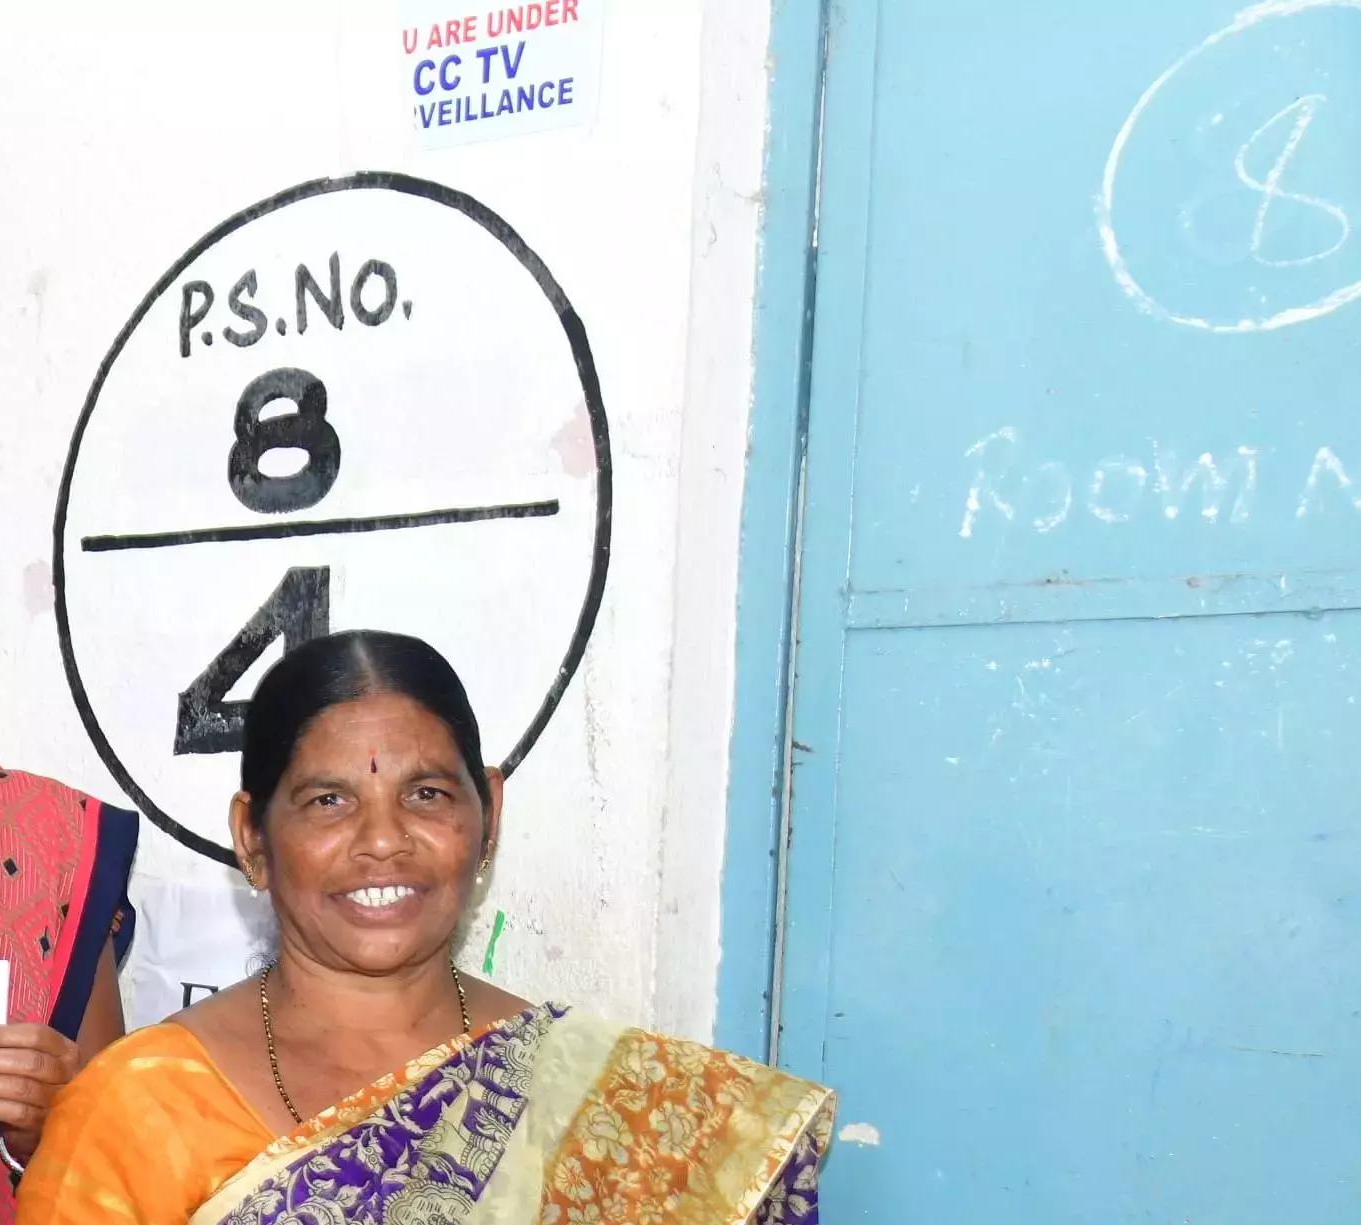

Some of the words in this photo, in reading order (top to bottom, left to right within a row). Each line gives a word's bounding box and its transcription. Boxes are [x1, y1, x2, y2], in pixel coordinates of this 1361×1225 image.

[426, 15, 477, 50] ARE
[487, 0, 579, 38] UNDER
[413, 54, 462, 96] CC
[476, 40, 526, 84] TV
[413, 77, 574, 129] VEILLANCE
[180, 251, 413, 358] P.S.NO.
[227, 367, 342, 514] 8
[173, 565, 331, 755] 4
